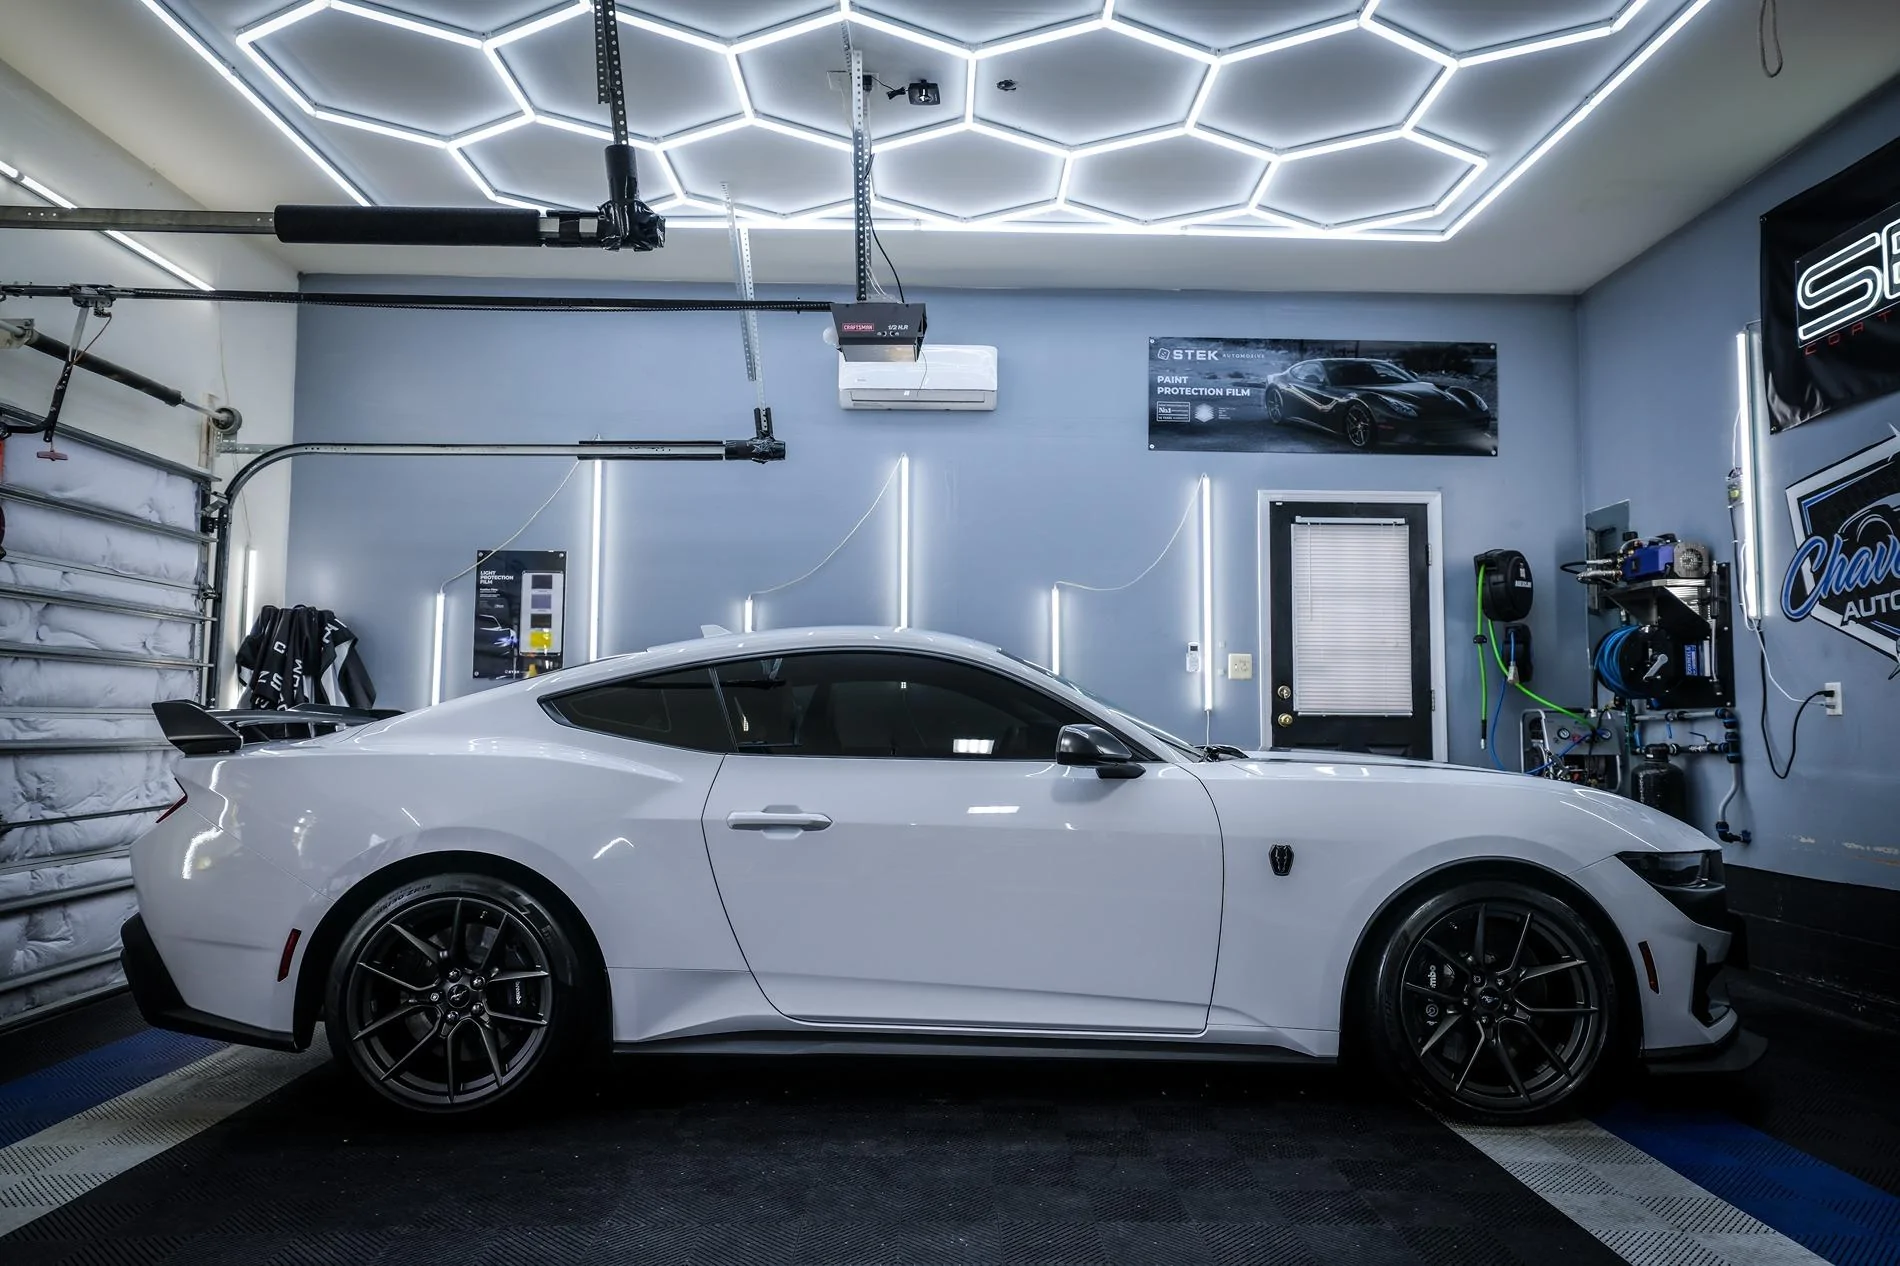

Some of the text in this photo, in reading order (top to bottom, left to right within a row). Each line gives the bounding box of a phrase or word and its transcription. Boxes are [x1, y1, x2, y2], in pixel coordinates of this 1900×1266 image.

[1173, 349, 1219, 361] STEK
[1157, 375, 1189, 384] PAINT
[1157, 386, 1251, 397] PROTECTION FILM
